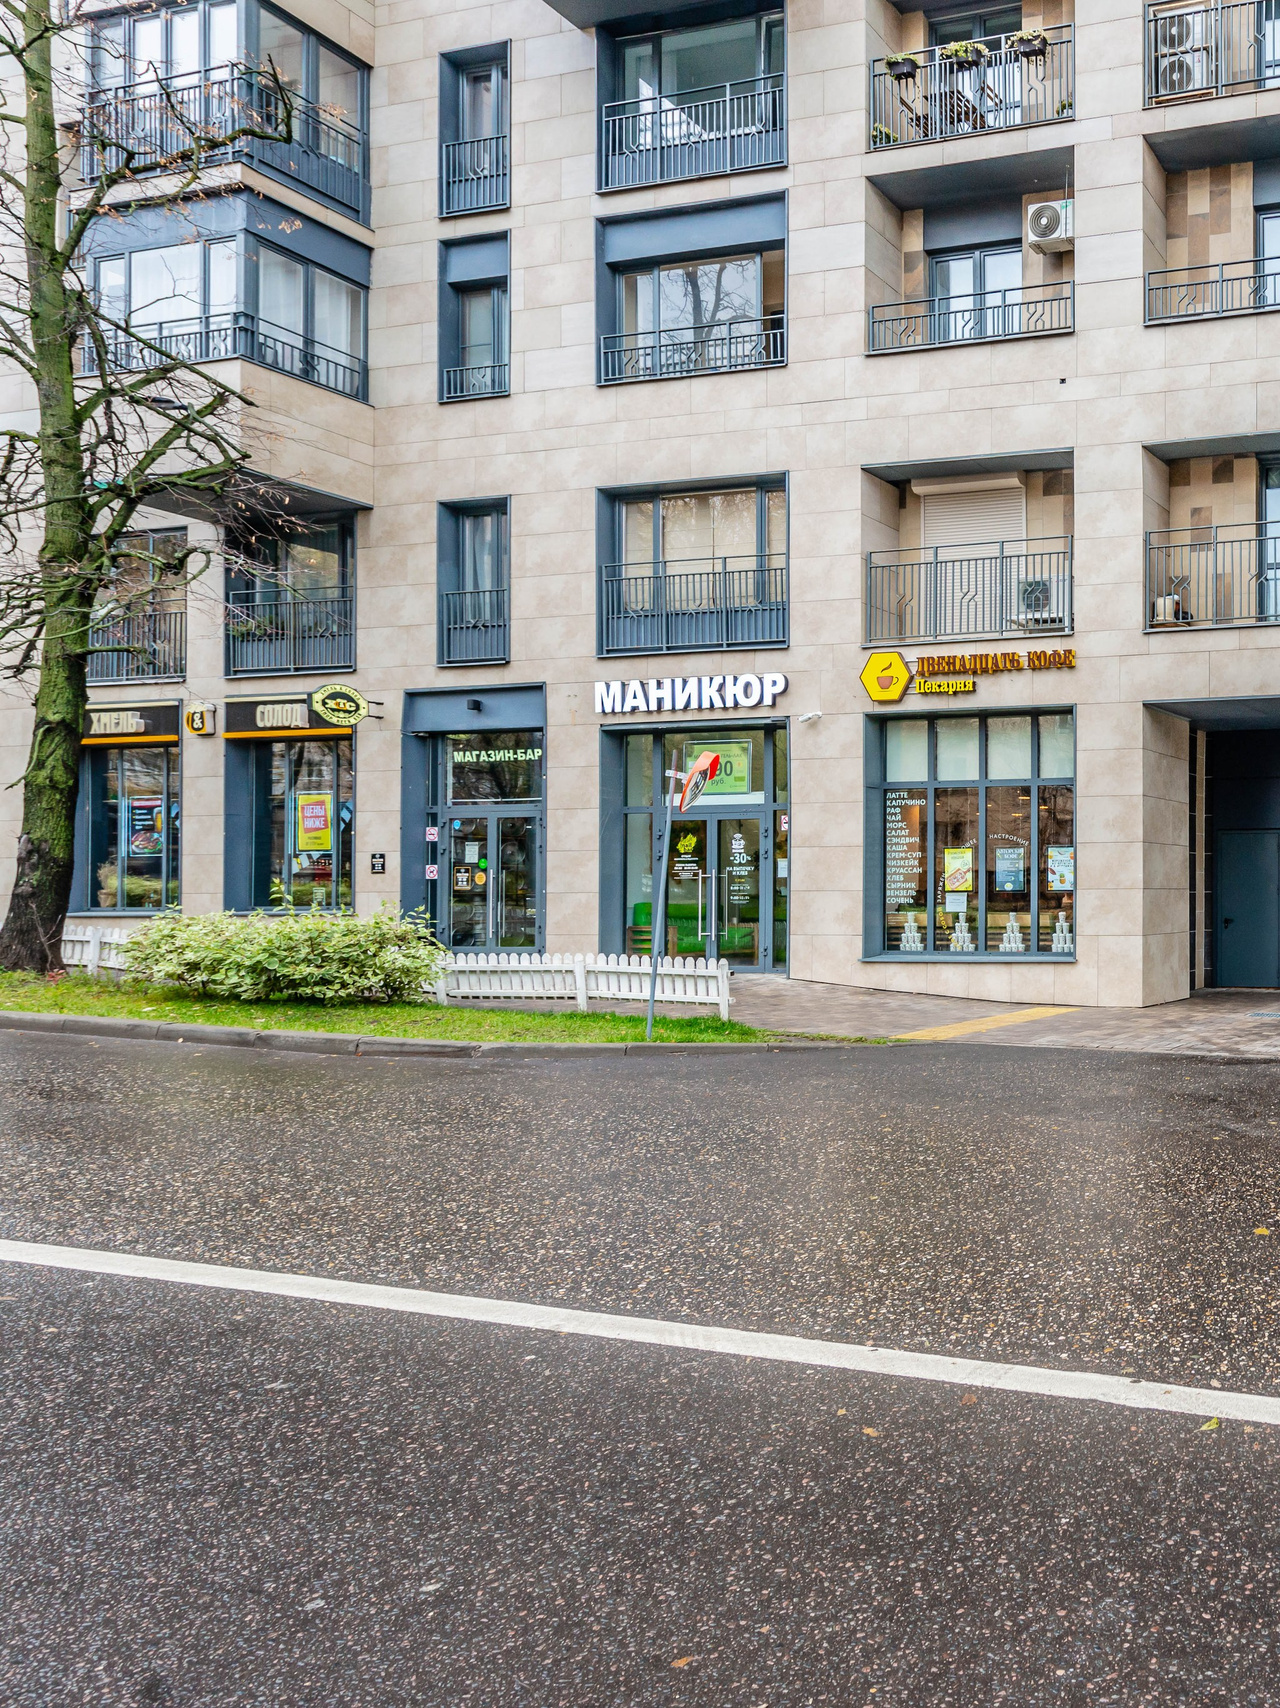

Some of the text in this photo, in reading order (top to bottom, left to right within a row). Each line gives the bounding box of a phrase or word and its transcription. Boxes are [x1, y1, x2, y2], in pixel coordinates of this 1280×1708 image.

[916, 649, 1076, 676] ДВЕНАДЦАТЬ КОФЕ
[594, 672, 788, 713] МАНИКЮР
[915, 679, 974, 694] Пекарня
[90, 711, 141, 734] ХМЕЛЬ
[256, 704, 304, 728] СОЛОД
[453, 748, 542, 762] МАГАЗИН-БАР
[304, 805, 325, 817] ЦЕНЫ
[304, 817, 325, 829] НИЖЕ
[989, 833, 1029, 846] НАСТРОЕНИЕ
